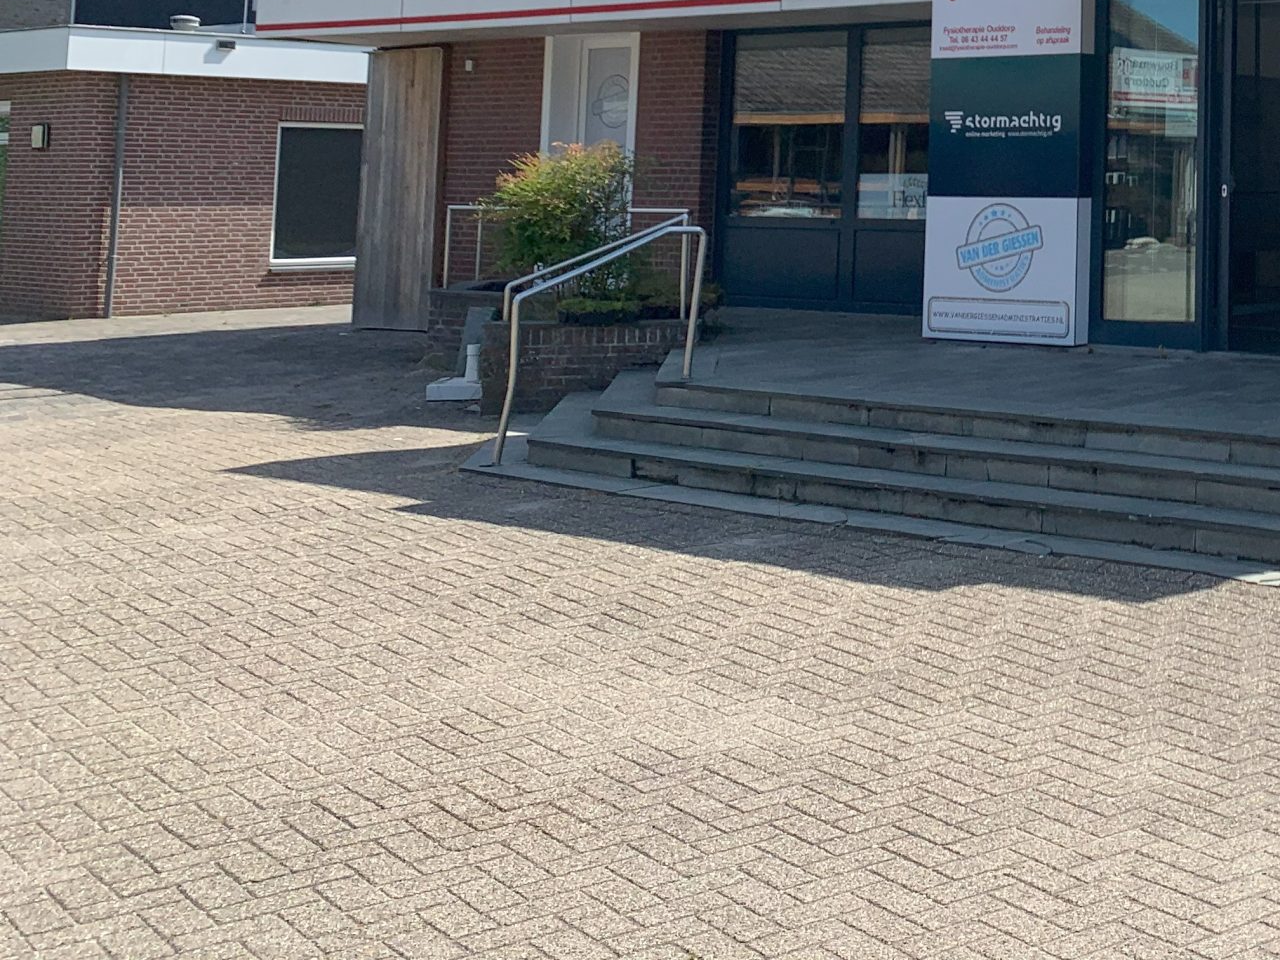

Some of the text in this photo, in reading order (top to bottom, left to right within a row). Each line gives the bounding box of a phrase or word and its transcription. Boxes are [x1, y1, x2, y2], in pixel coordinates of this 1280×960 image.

[943, 24, 1016, 37] Fysiotherapie Ouddorp
[1035, 26, 1071, 35] Behandeling
[1045, 36, 1070, 45] afspraak
[965, 111, 1062, 132] stormachtig
[981, 130, 1006, 138] marketing
[959, 230, 1039, 263] VAN DER GIESSEN
